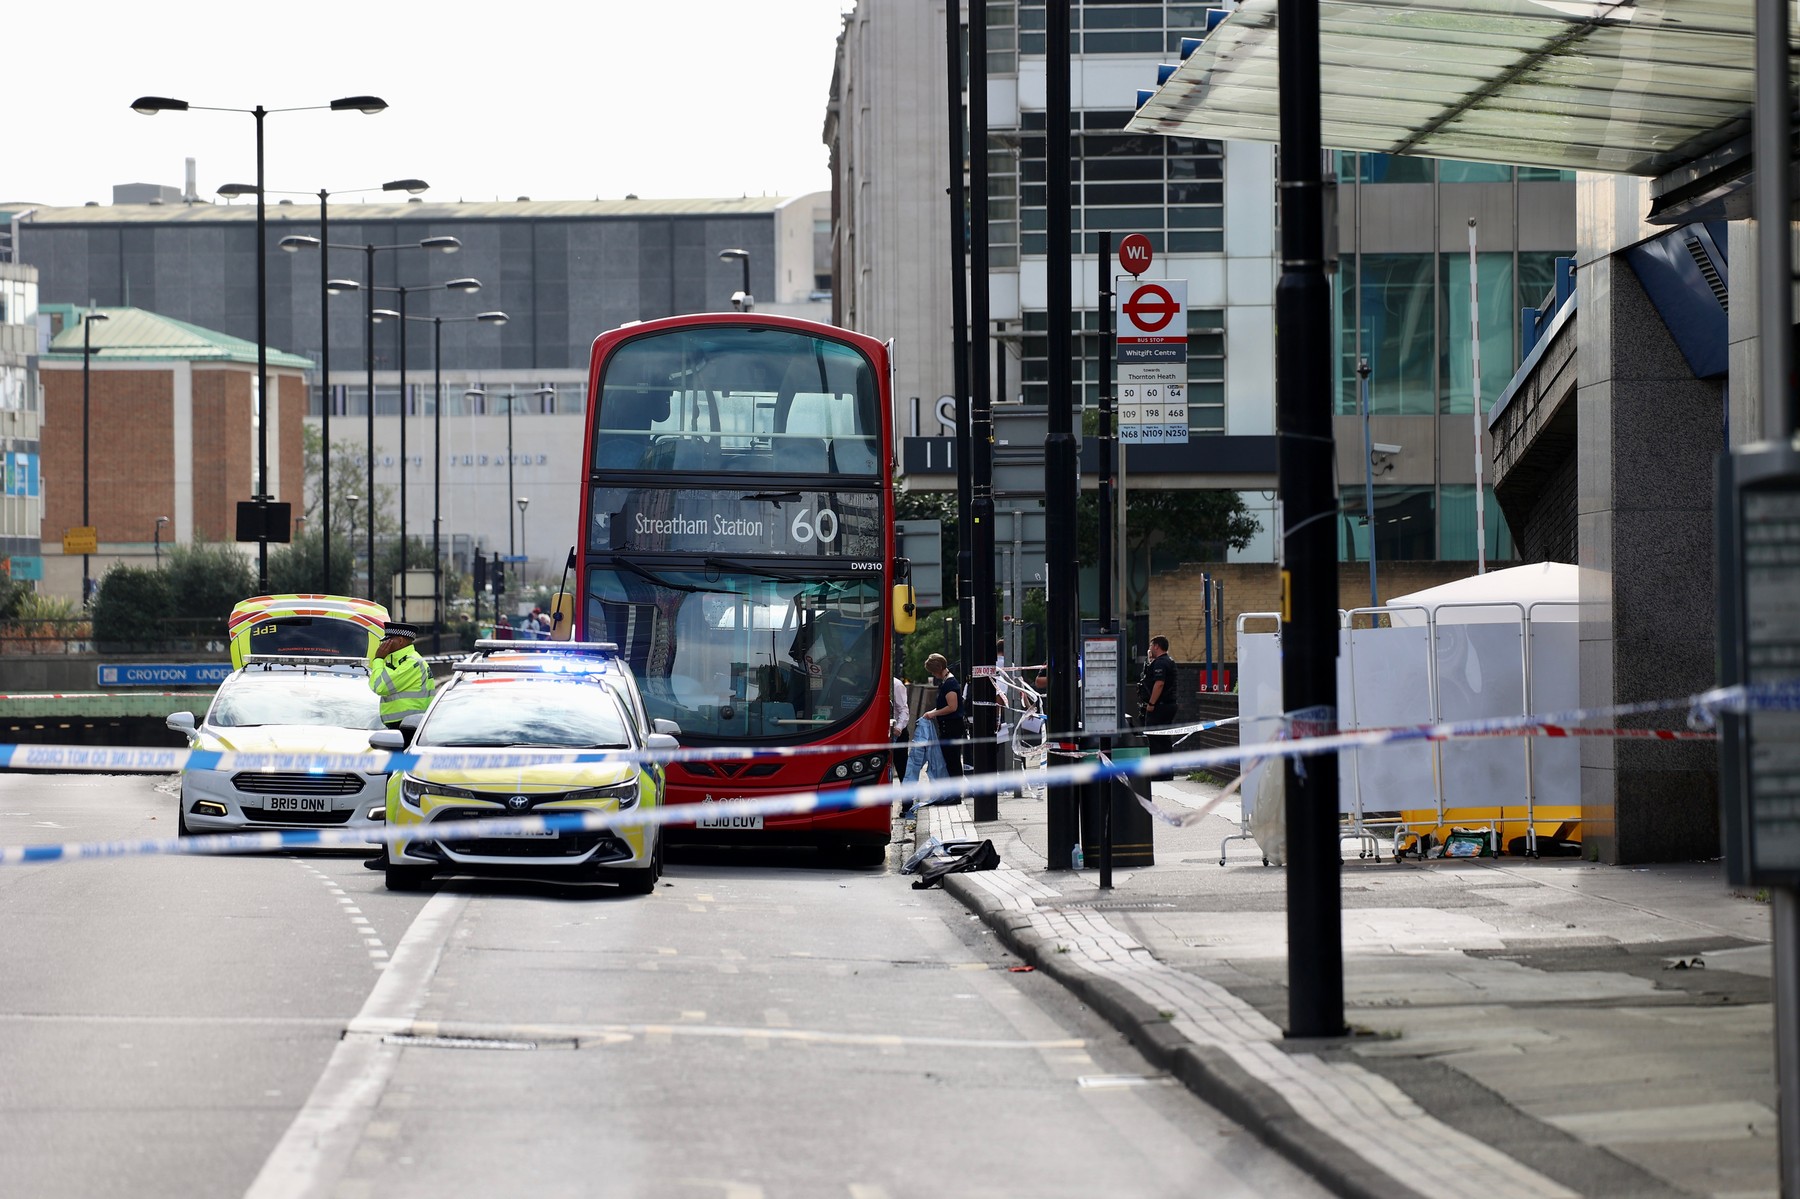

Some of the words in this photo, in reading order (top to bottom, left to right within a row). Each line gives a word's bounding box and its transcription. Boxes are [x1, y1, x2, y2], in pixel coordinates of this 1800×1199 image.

[1126, 245, 1149, 260] WL
[1125, 349, 1153, 358] Whitgift
[1124, 389, 1135, 397] 50
[1146, 389, 1158, 397] 60
[1170, 389, 1181, 397] 64
[1122, 410, 1137, 418] 109
[1145, 409, 1160, 417] 198
[1168, 409, 1184, 417] 468
[1121, 430, 1139, 439] N68
[1142, 429, 1163, 438] N109
[1165, 429, 1187, 437] N250
[635, 513, 708, 535] Streatham
[713, 514, 763, 537] Station
[791, 508, 839, 543] 60
[851, 562, 883, 571] DW310
[252, 624, 277, 637] EPF
[127, 669, 187, 681] CROYDON
[196, 669, 233, 680] UNDE
[271, 797, 298, 809] BR19
[301, 798, 325, 810] ONN
